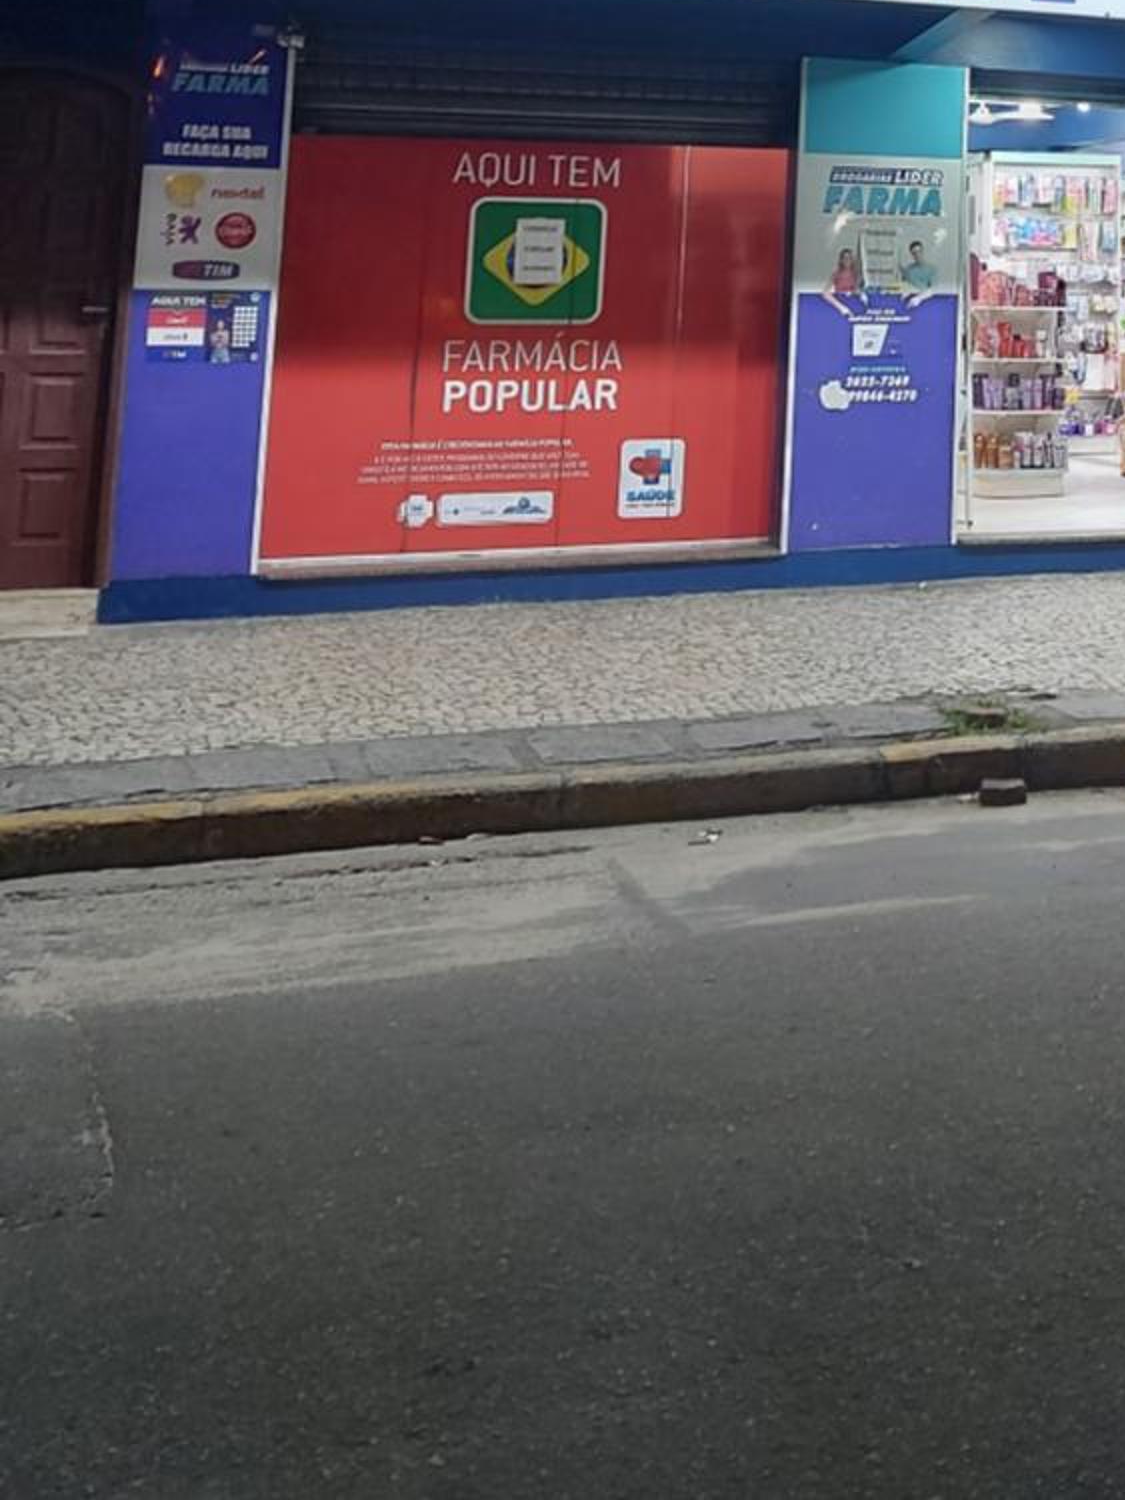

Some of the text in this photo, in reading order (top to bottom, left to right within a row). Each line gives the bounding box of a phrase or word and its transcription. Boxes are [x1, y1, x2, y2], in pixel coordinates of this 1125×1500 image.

[171, 72, 269, 96] FARMA
[452, 152, 621, 188] AQUI TEM
[894, 168, 944, 186] LIDER
[822, 185, 942, 217] FARMA
[203, 263, 235, 277] TIM
[442, 331, 622, 373] FARMÁCIA
[442, 379, 618, 413] POPULAR
